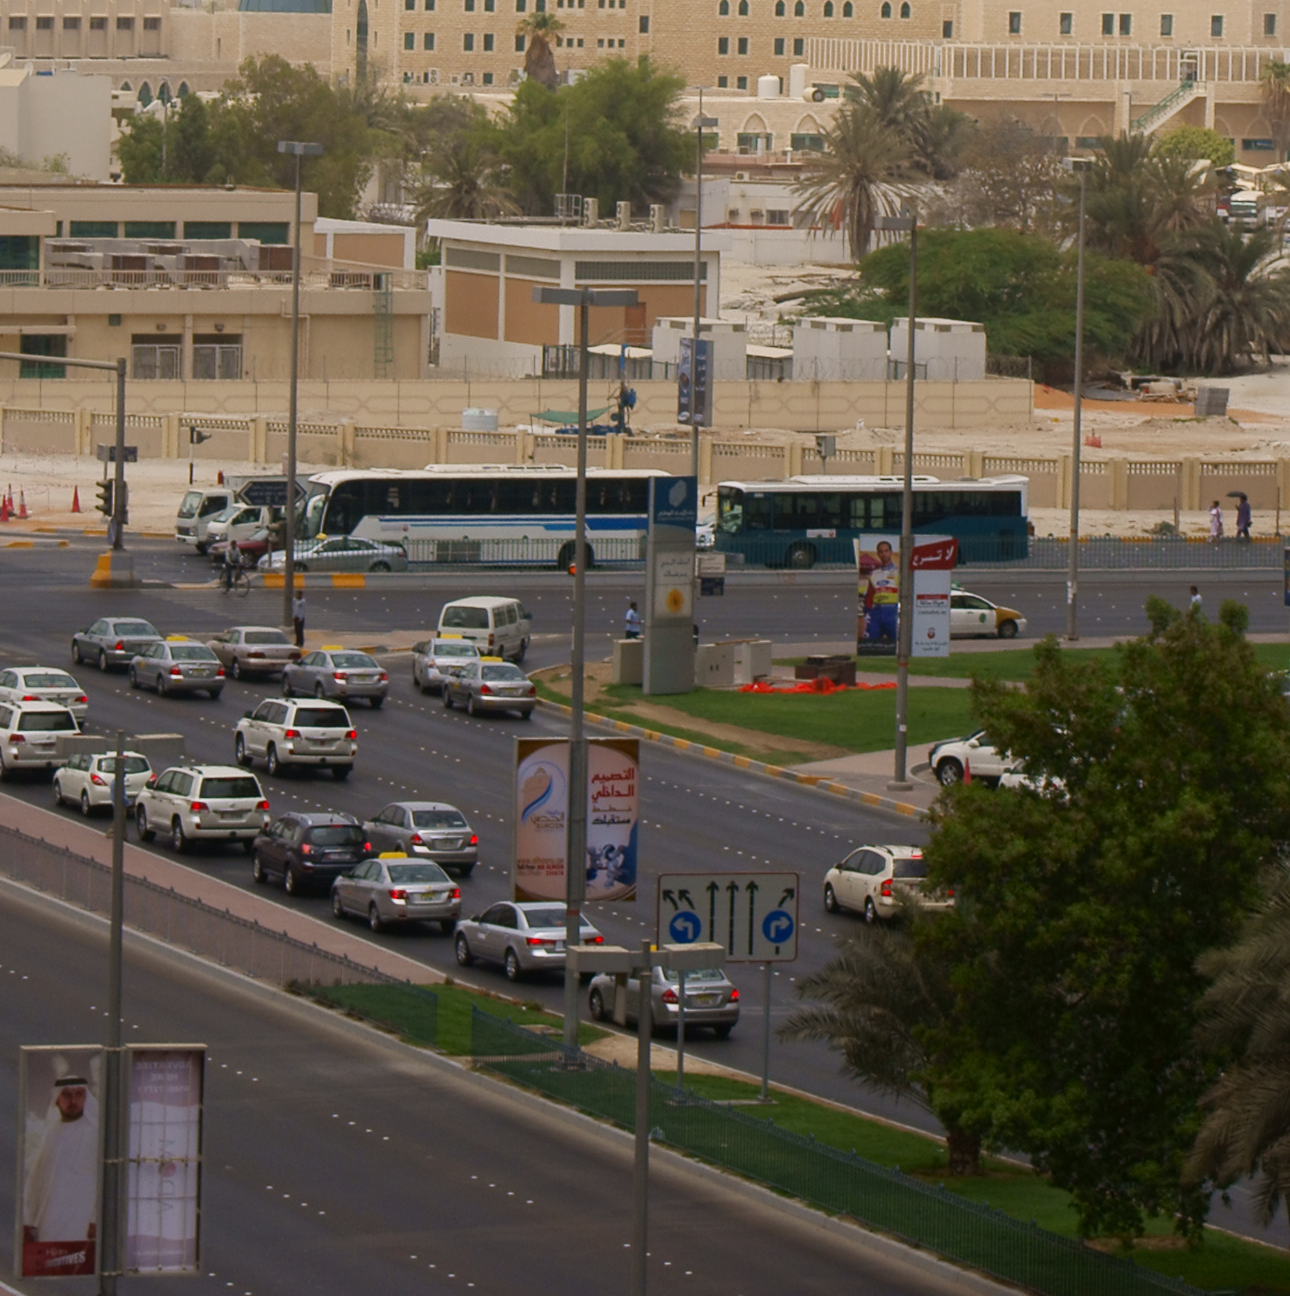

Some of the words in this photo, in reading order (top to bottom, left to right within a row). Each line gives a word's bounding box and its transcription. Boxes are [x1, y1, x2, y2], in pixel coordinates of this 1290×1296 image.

[912, 549, 943, 567] تسرع
[944, 545, 955, 561] لا
[591, 767, 635, 785] التصميم
[591, 784, 635, 804] الداخلي
